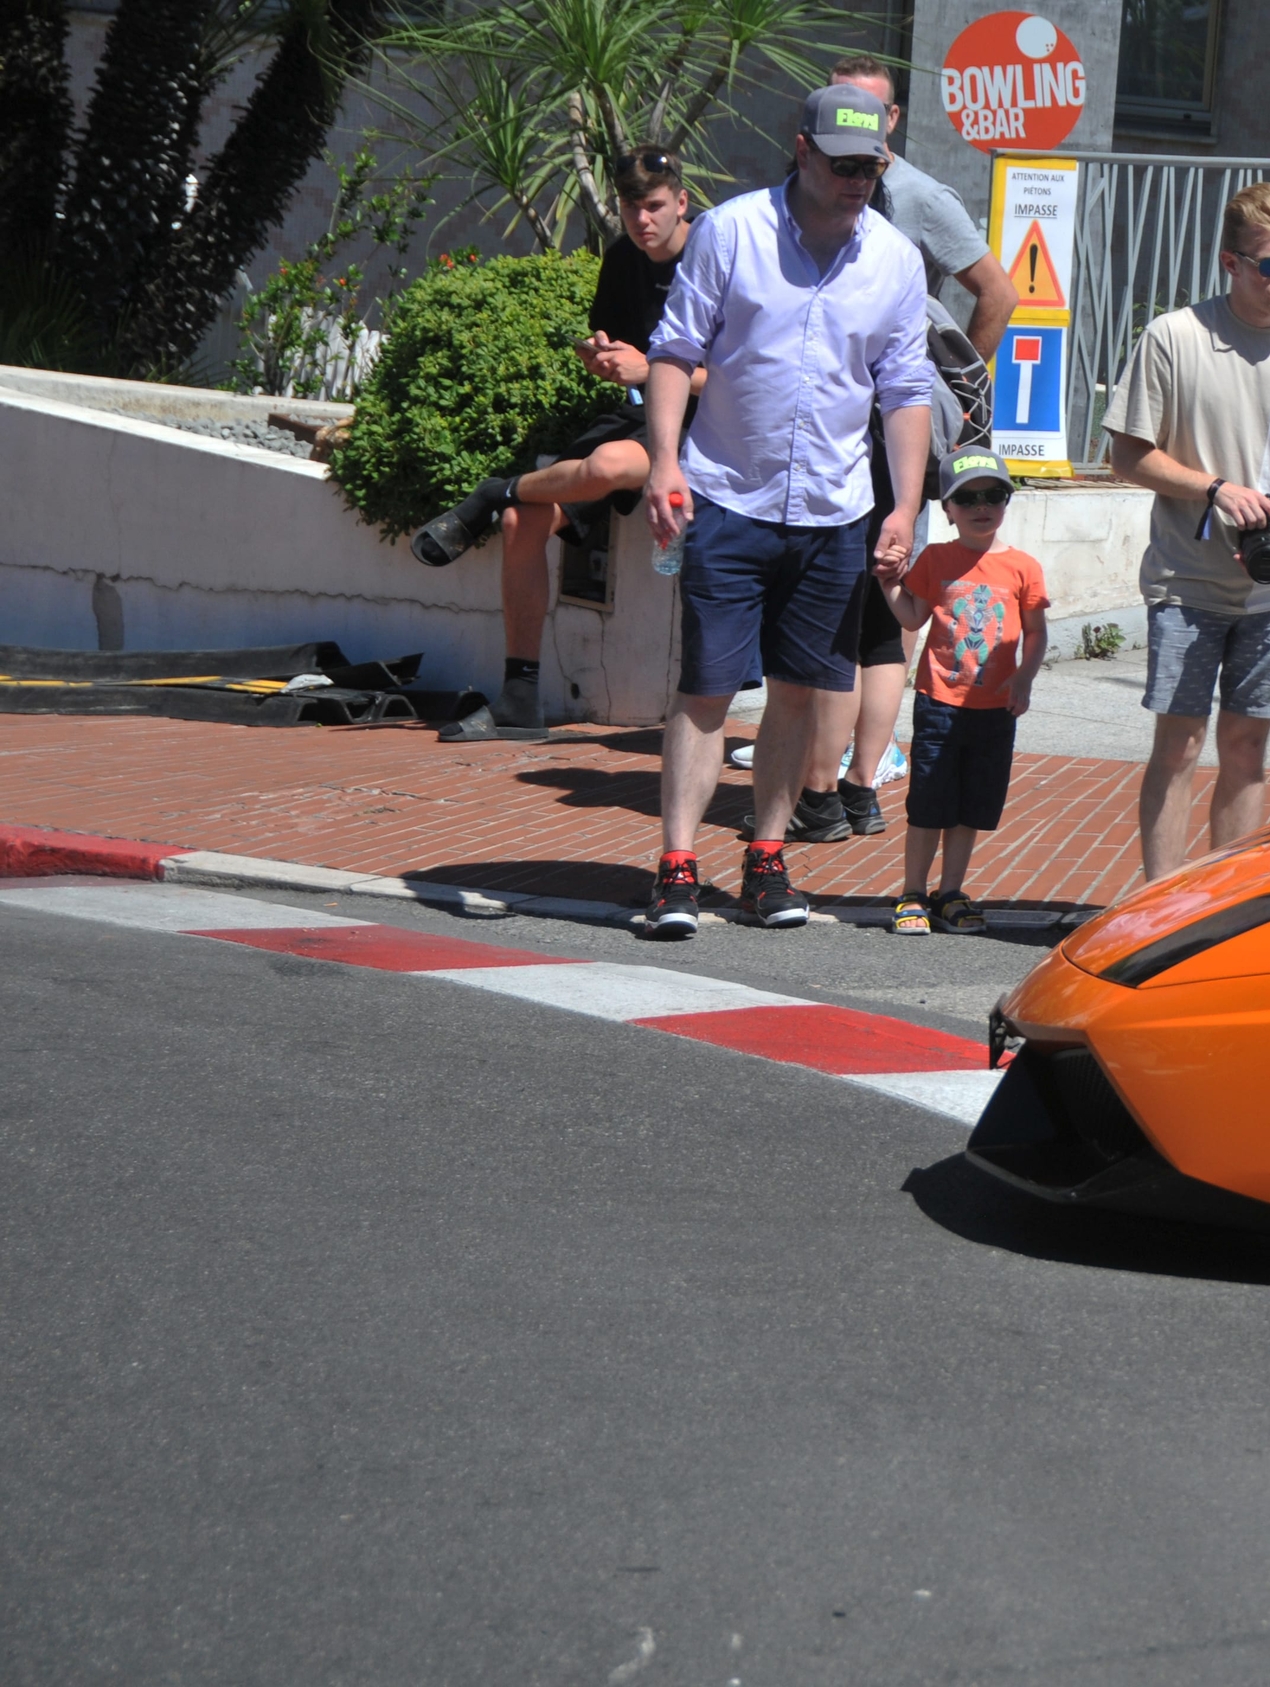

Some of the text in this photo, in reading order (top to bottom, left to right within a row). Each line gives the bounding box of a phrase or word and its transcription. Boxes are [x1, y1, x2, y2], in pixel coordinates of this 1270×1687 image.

[941, 61, 1086, 112] BOWLING
[961, 108, 1026, 141] &BAR
[1011, 172, 1065, 182] ATTENTION AUX
[1023, 184, 1052, 196] PIÉTONS
[1014, 203, 1058, 217] IMPASSE
[998, 444, 1045, 457] IMPASSE
